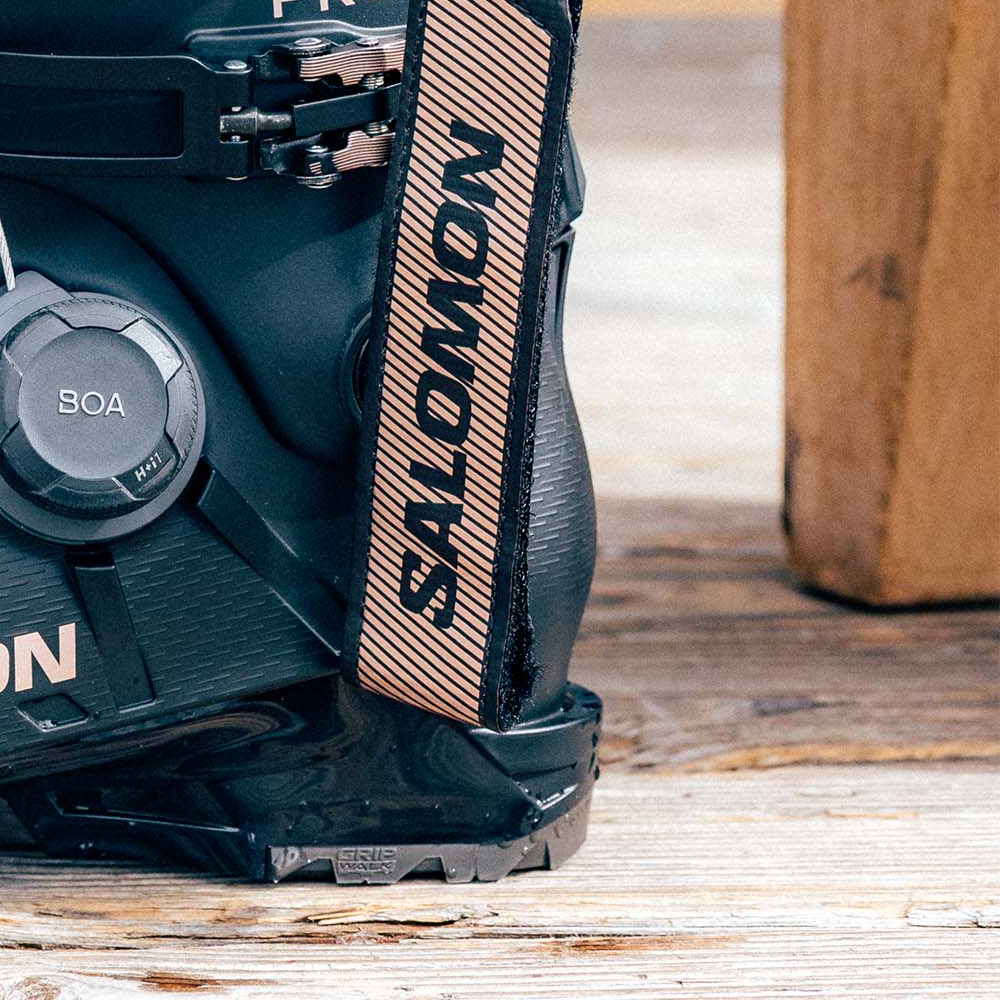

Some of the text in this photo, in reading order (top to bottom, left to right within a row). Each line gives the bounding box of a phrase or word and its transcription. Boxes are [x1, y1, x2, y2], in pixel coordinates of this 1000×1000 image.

[399, 118, 505, 631] SALOMON
[58, 389, 126, 418] BOA
[335, 846, 398, 861] GRIP
[337, 862, 394, 874] WALK
